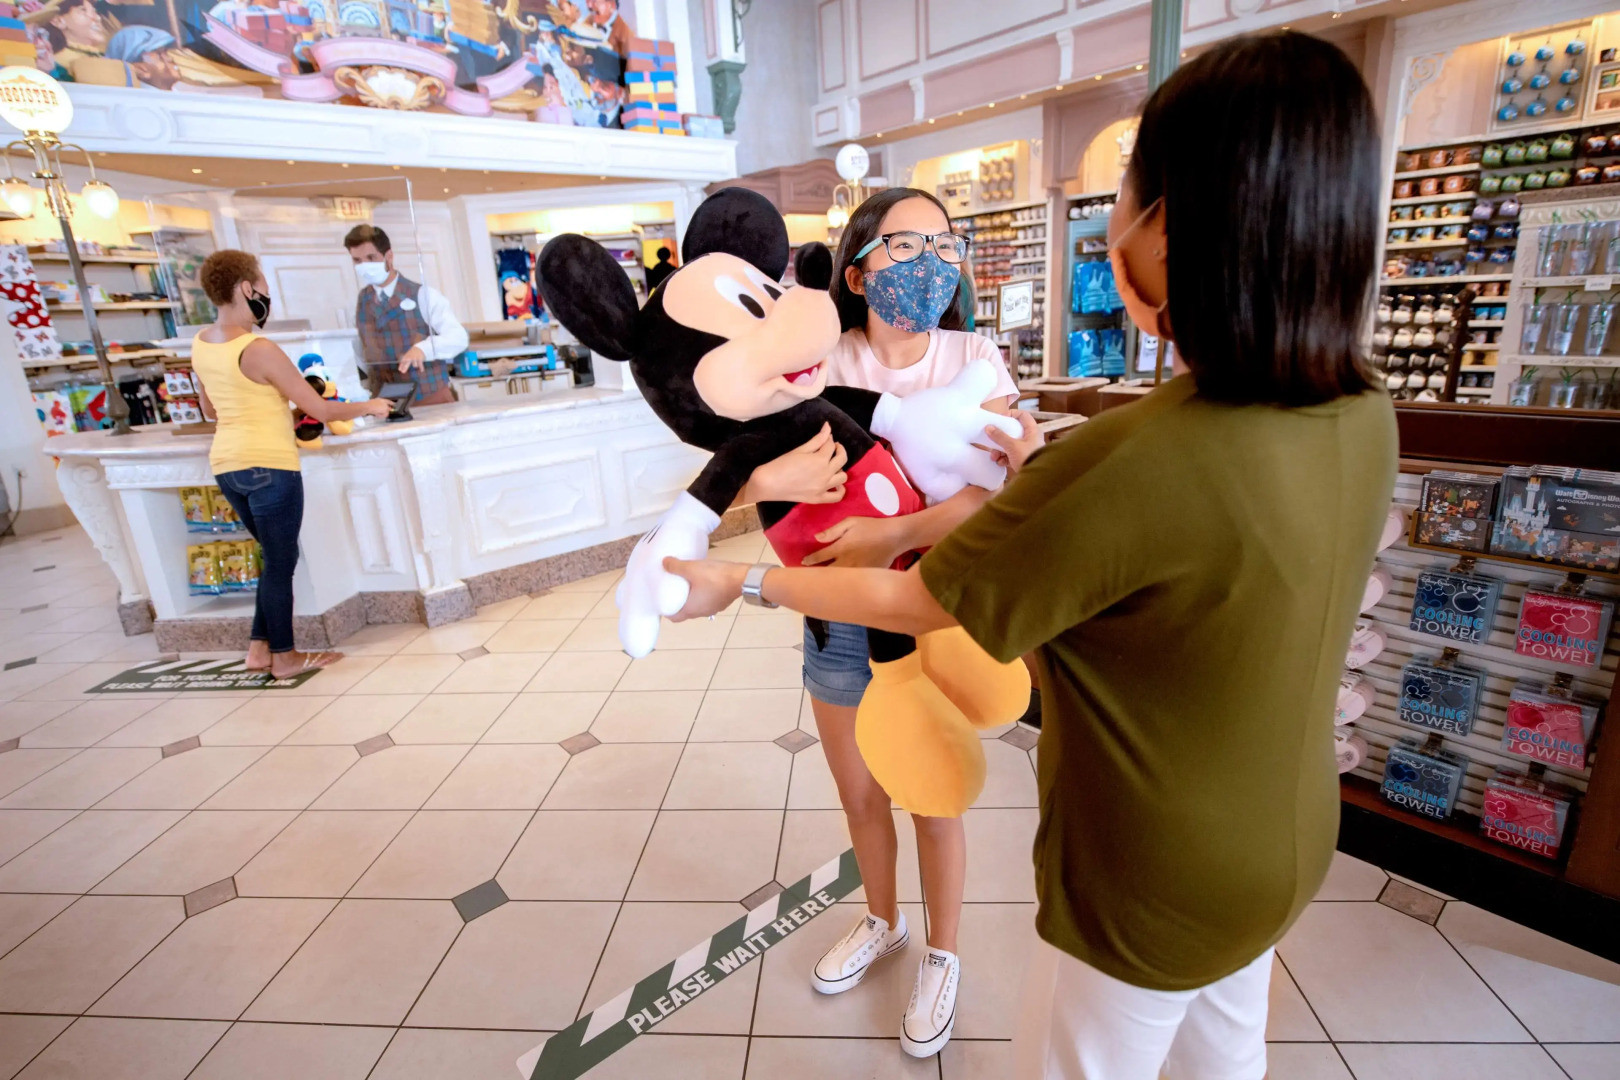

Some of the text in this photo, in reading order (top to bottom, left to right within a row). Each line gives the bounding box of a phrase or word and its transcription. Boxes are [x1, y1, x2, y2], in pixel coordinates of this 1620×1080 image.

[341, 200, 363, 216] EXIT
[1557, 498, 1594, 506] AUTOGRAPHS
[1416, 606, 1485, 630] COOLING
[1416, 618, 1480, 642] TOWEL
[1520, 628, 1599, 652] COOLING
[1520, 640, 1594, 665] TOWEL
[264, 679, 297, 687] LINE
[1400, 697, 1469, 722] COOLING
[1400, 708, 1464, 734] TOWEL
[1508, 727, 1584, 755] COOLING
[1508, 738, 1580, 767] TOWEL
[1384, 780, 1448, 808] COOLING
[1385, 789, 1444, 819] TOWEL
[1485, 815, 1556, 846] COOLING
[1485, 825, 1553, 857] TOWEL
[627, 890, 836, 1035] PLEASE WAIT HERE
